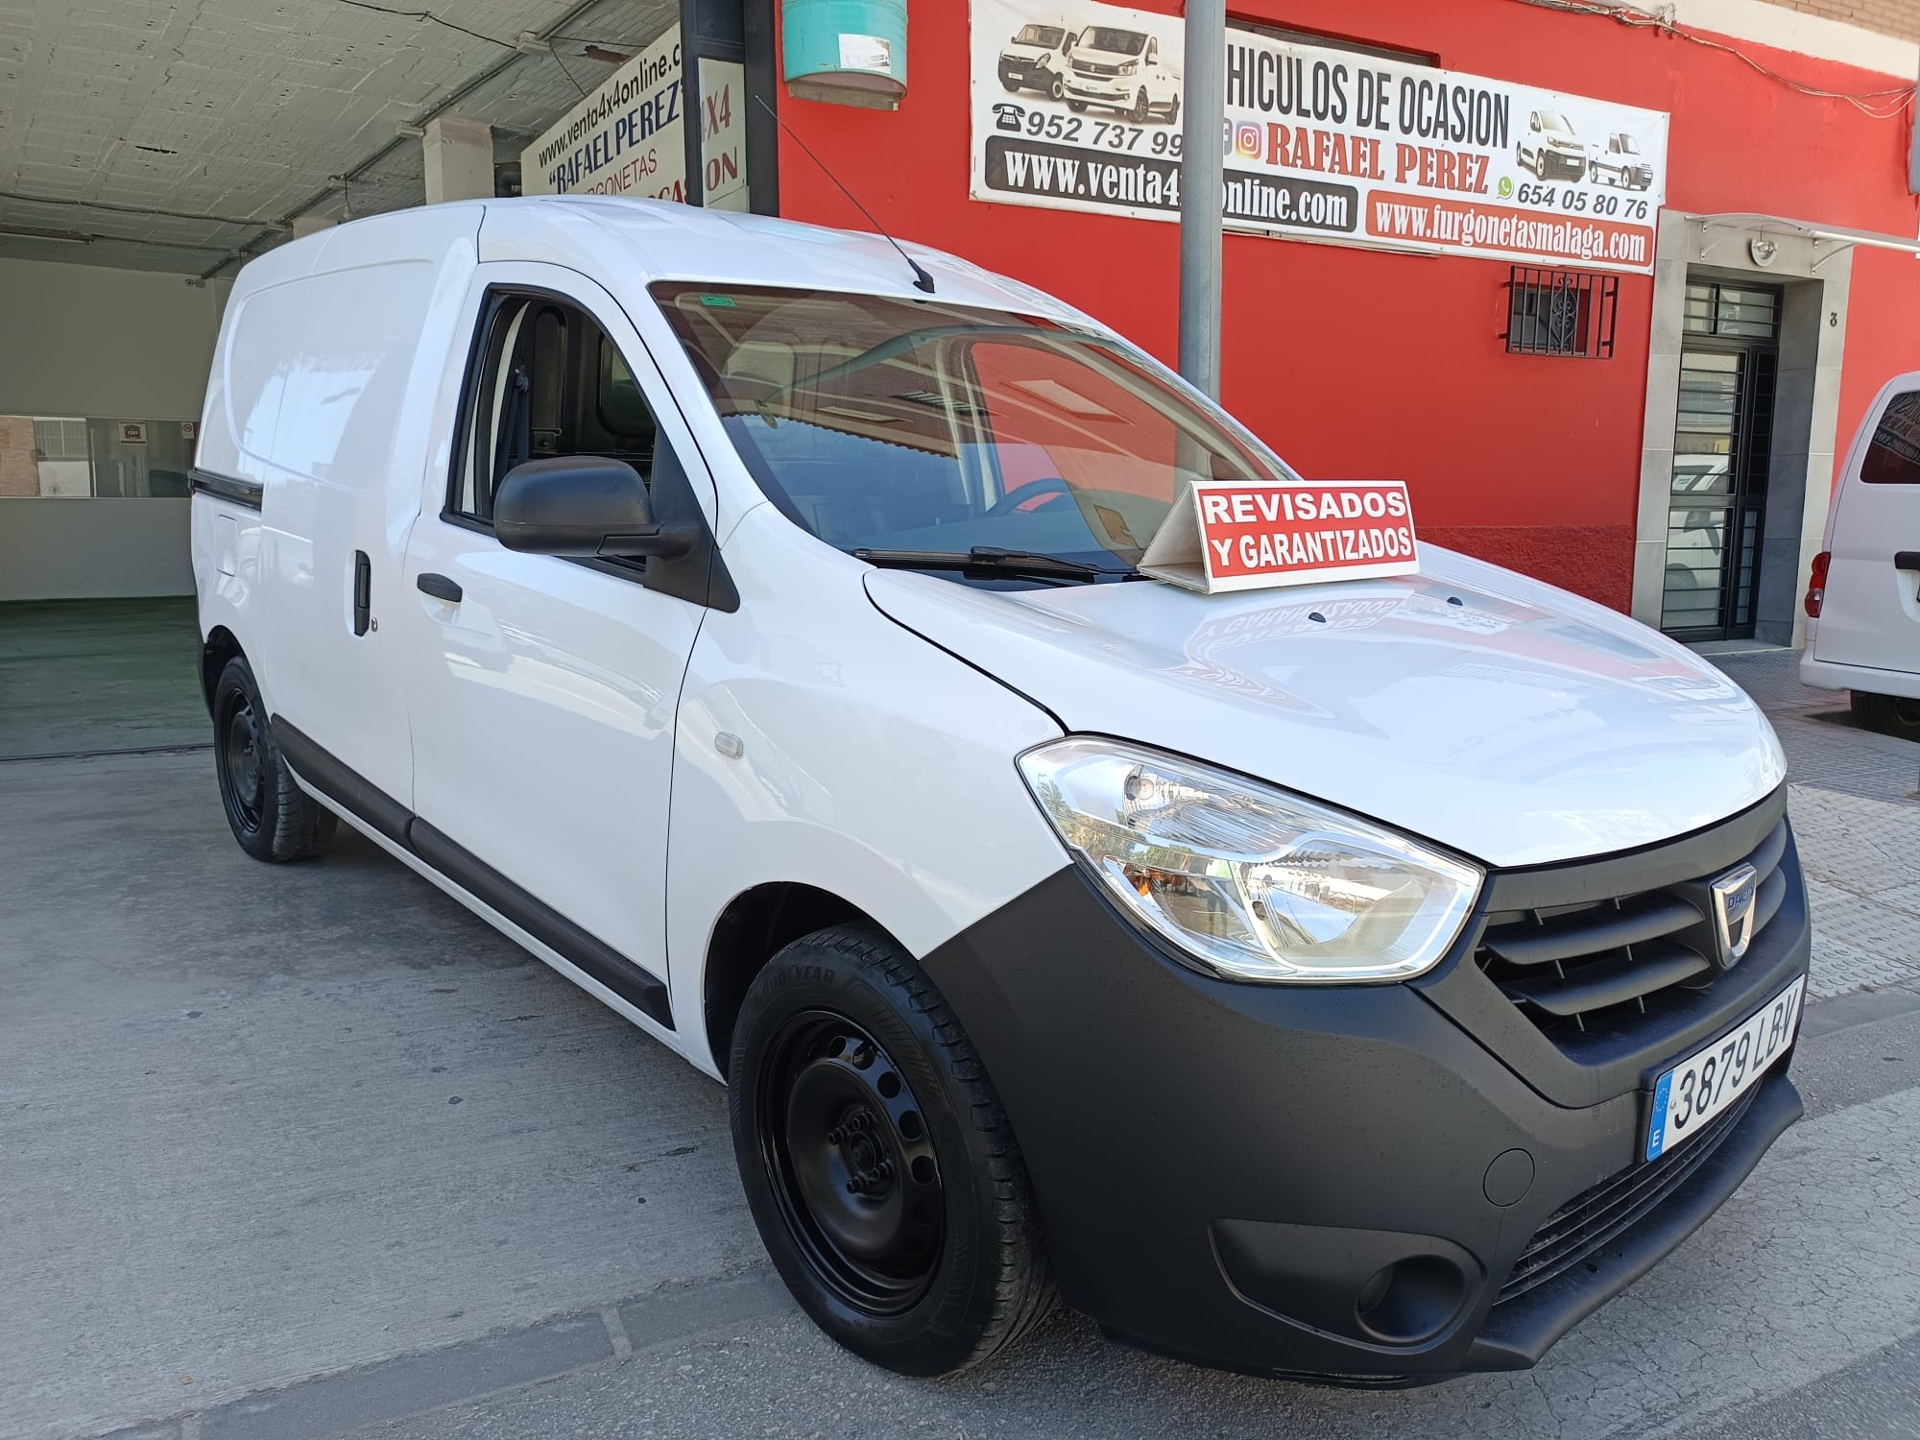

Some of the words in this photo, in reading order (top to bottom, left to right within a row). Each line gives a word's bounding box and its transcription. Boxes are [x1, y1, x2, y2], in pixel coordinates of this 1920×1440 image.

[1227, 44, 1348, 124] HICULOS
[1356, 69, 1391, 131] DE
[1400, 76, 1509, 149] OCASION
[1026, 111, 1082, 142] 952
[1092, 121, 1144, 151] 737
[1151, 131, 1183, 157] 99
[585, 148, 657, 196] GONETAS
[1266, 122, 1385, 181] RAFAEL
[1395, 143, 1490, 195] PEREZ
[1517, 183, 1555, 207] 654
[1561, 189, 1587, 212] 05
[1592, 194, 1618, 216] 80
[1623, 198, 1648, 220] 76
[1375, 201, 1645, 263] www.furgonetasmalaga.com
[1202, 491, 1406, 524] REVISADOS
[1211, 538, 1233, 566] Y
[1239, 527, 1411, 568] GARANTIZADOS
[1673, 1031, 1750, 1130] 3879
[1752, 988, 1799, 1073] LBV
[1652, 1129, 1660, 1147] E
